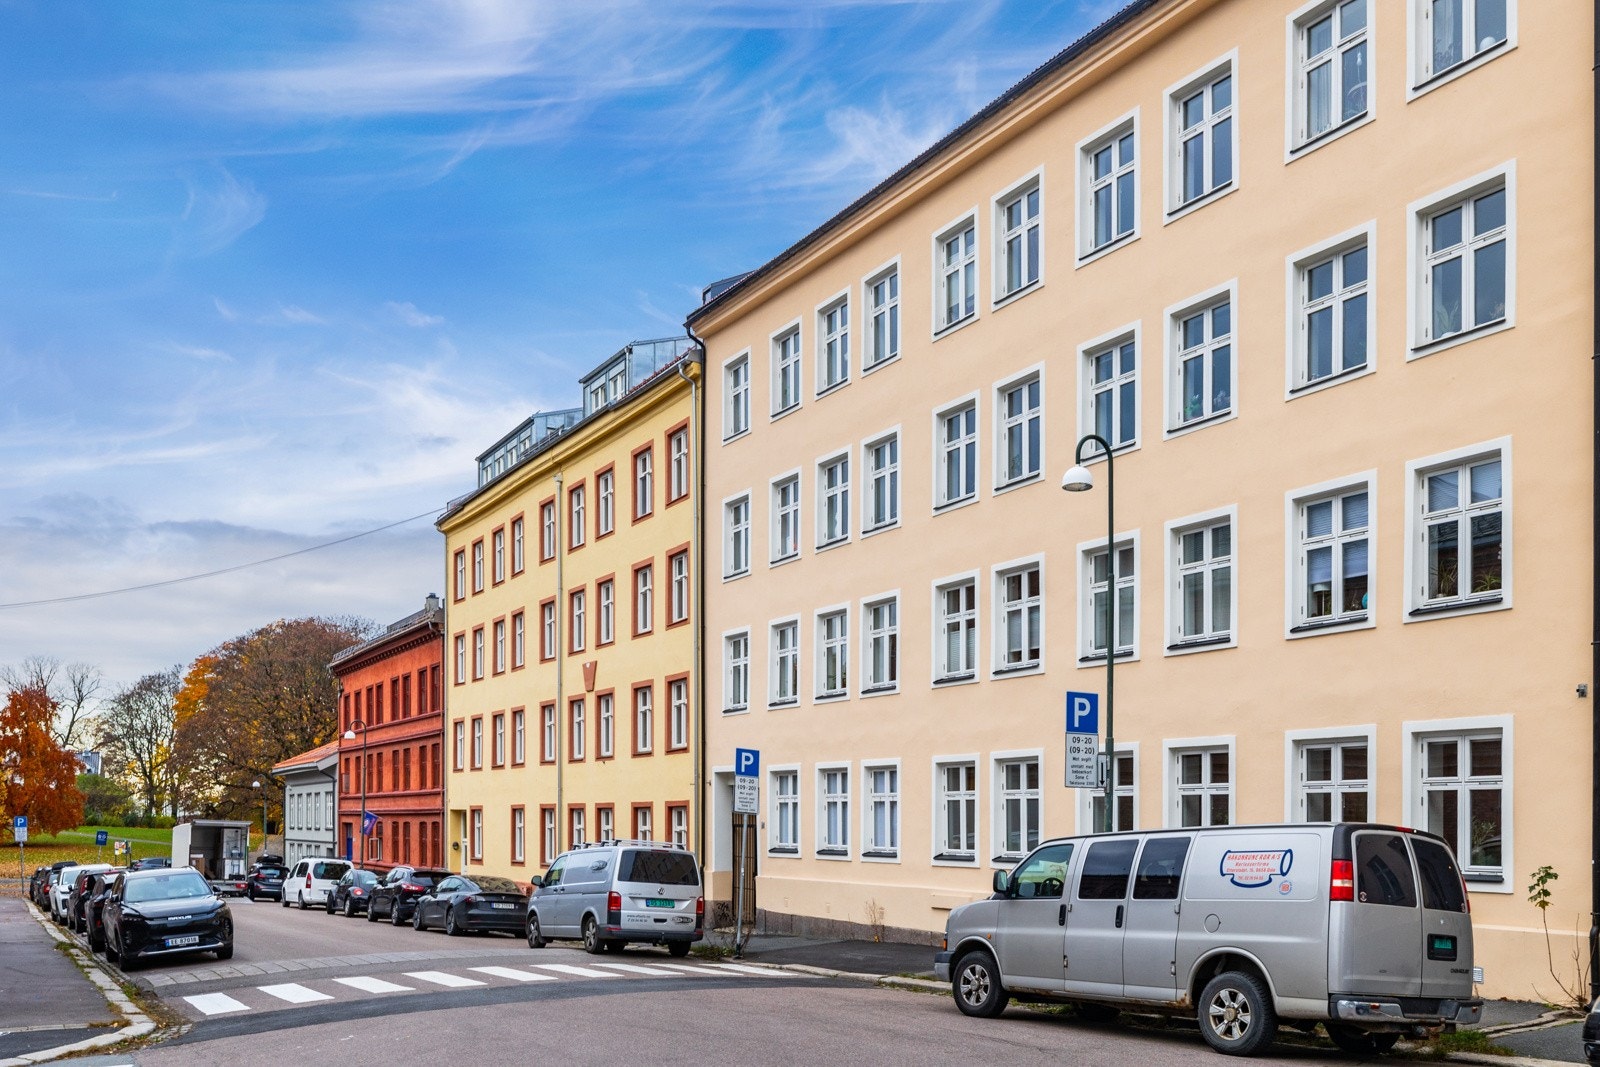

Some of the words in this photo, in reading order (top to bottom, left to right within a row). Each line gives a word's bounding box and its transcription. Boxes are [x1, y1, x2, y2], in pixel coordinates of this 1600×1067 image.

[1074, 697, 1091, 728] P
[741, 751, 754, 773] P
[17, 817, 24, 826] P
